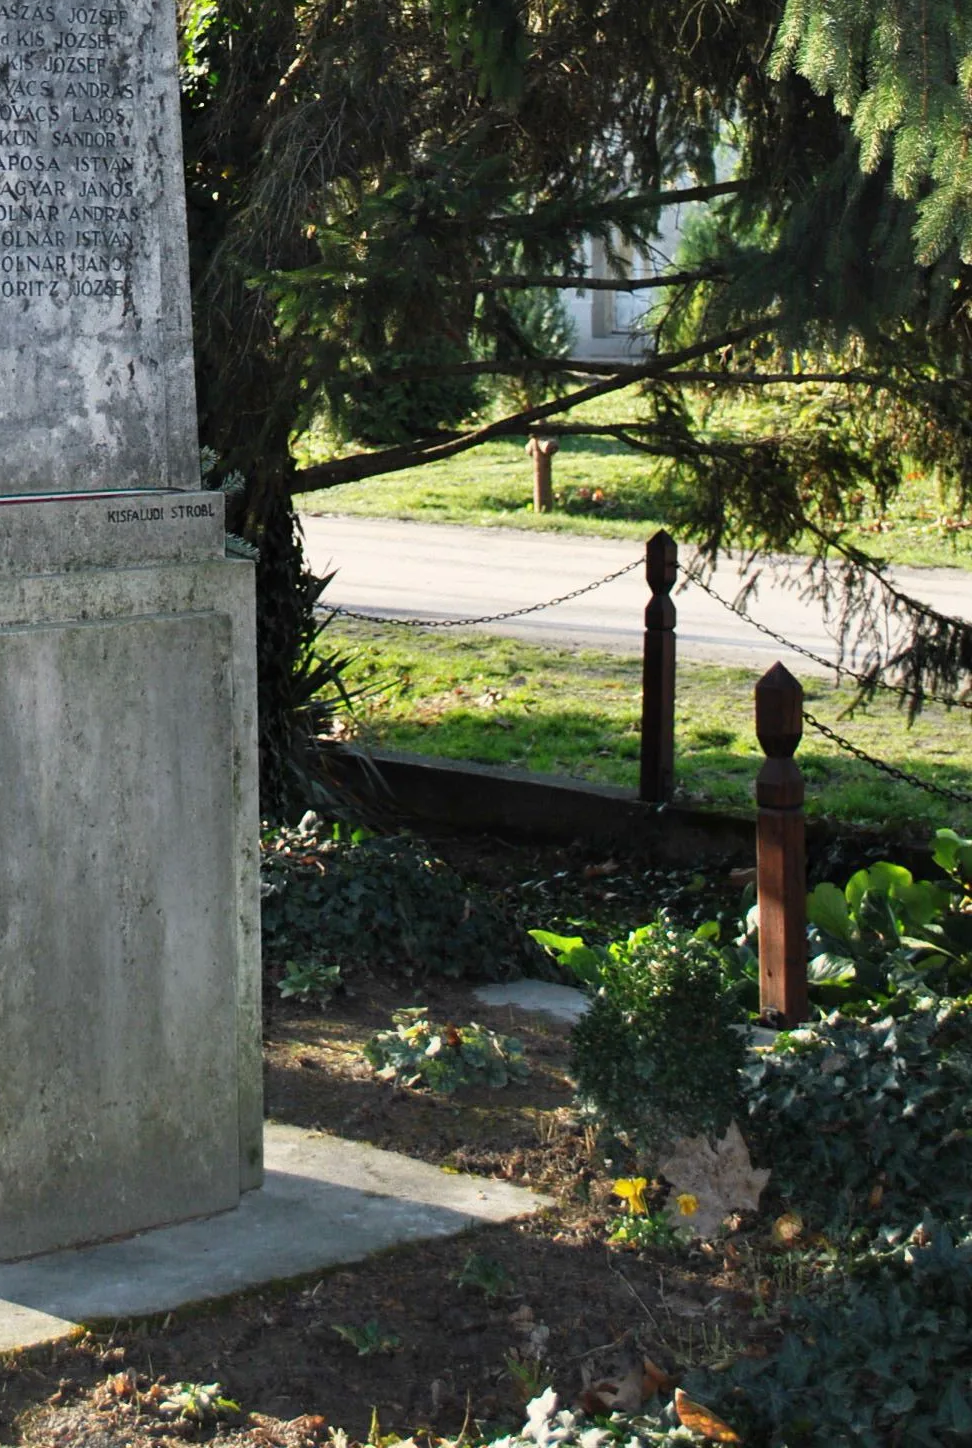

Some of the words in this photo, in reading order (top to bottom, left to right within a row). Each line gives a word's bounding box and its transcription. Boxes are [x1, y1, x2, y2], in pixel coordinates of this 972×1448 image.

[17, 31, 45, 48] KIS
[72, 108, 125, 124] LAJOS
[107, 507, 164, 523] KISFALUDI
[171, 503, 216, 519] STROBL
